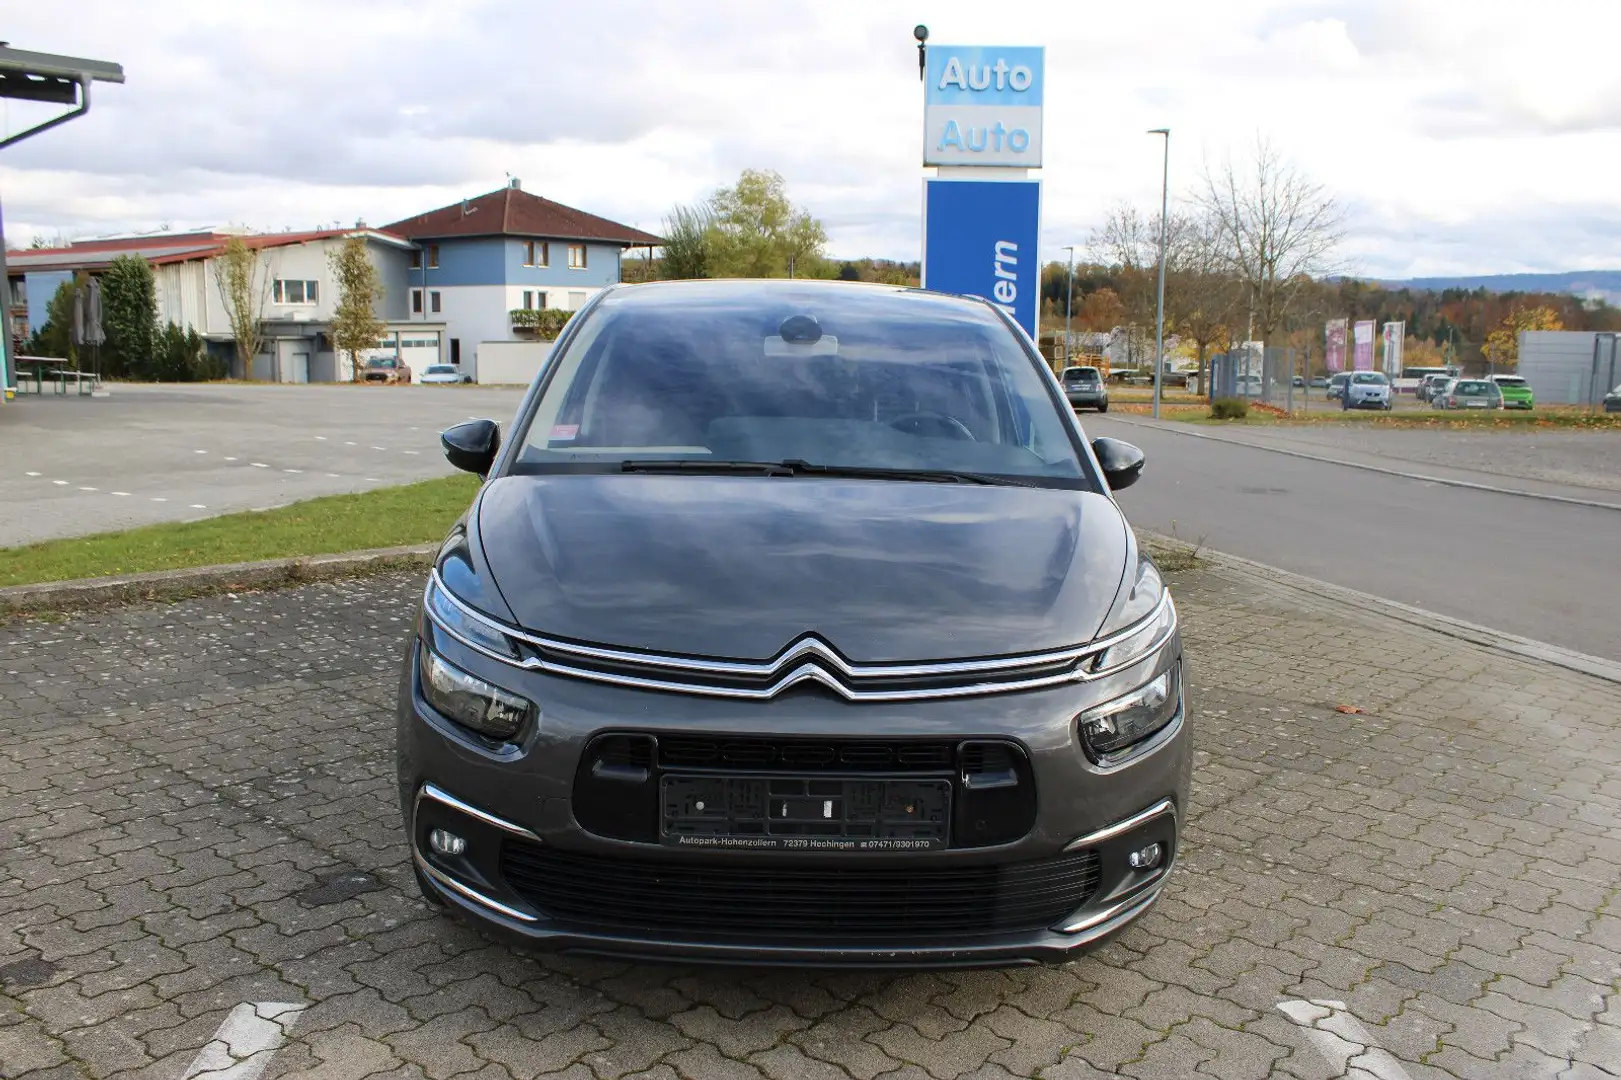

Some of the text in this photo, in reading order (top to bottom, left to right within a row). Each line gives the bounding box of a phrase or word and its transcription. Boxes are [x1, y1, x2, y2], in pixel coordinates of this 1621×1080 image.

[938, 56, 1033, 92] Auto
[937, 119, 1030, 153] Auto
[783, 839, 808, 848] 72379
